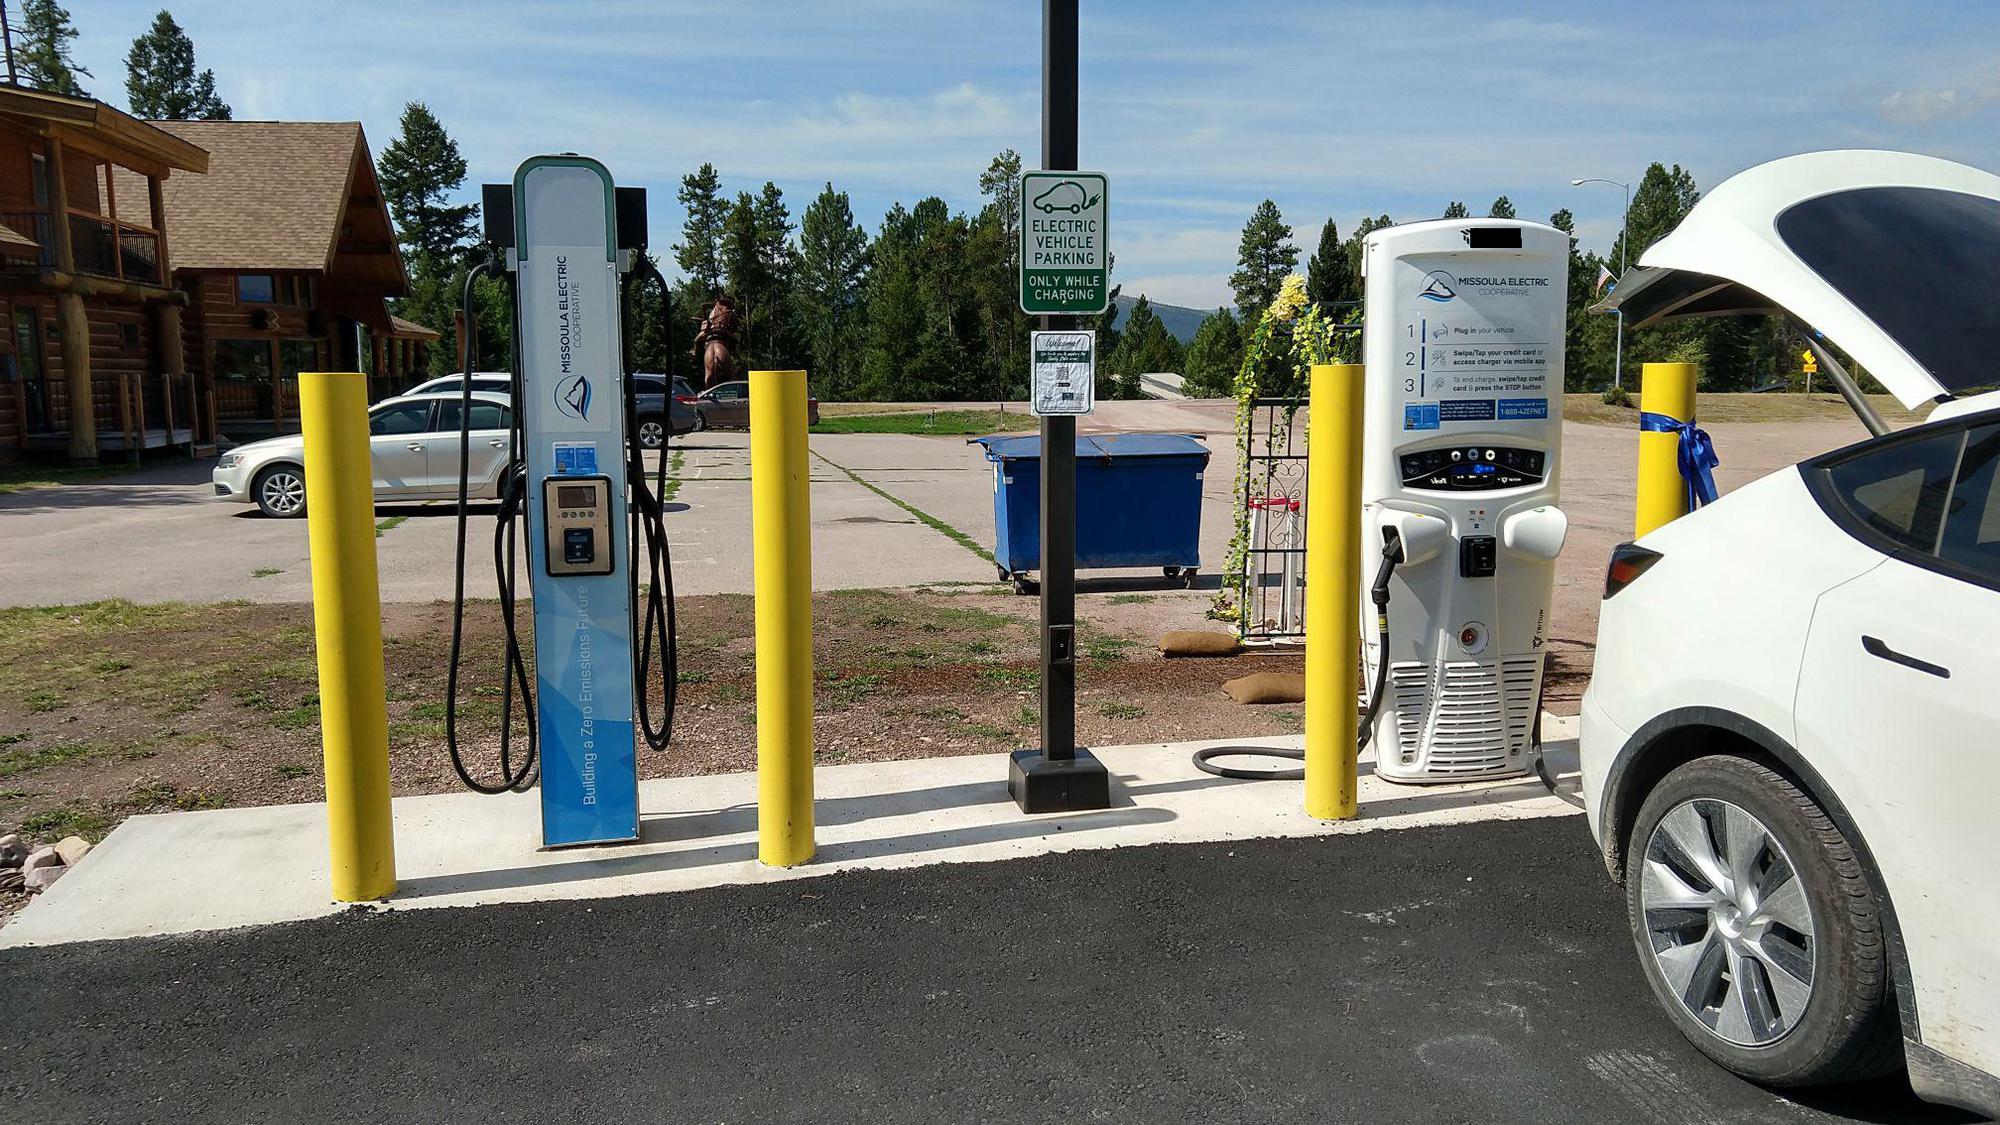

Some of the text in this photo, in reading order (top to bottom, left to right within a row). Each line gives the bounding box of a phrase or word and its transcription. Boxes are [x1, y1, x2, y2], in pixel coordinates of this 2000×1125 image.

[1032, 220, 1096, 233] ELECTRIC
[1036, 236, 1094, 249] VEHICLE
[1034, 252, 1094, 265] PARKING
[1029, 275, 1100, 287] ONLY WHILE
[1458, 277, 1550, 287] MISSOULA ELECTRIC
[1034, 289, 1094, 301] CHARGING
[1478, 288, 1530, 297] COOPERATIVE
[556, 255, 571, 373] MISSOULA ELECTRIC
[570, 282, 582, 349] COOPERATIVE
[1407, 324, 1414, 338] 1
[1453, 327, 1469, 335] Plug
[1478, 327, 1492, 335] your
[1405, 351, 1416, 366] 2
[1477, 359, 1501, 367] charger
[1404, 378, 1415, 392] 3
[1498, 375, 1528, 383] swipe/tap
[1528, 374, 1546, 382] credit
[1522, 383, 1542, 391] button
[575, 584, 598, 806] Building a Zero Emissions Future
